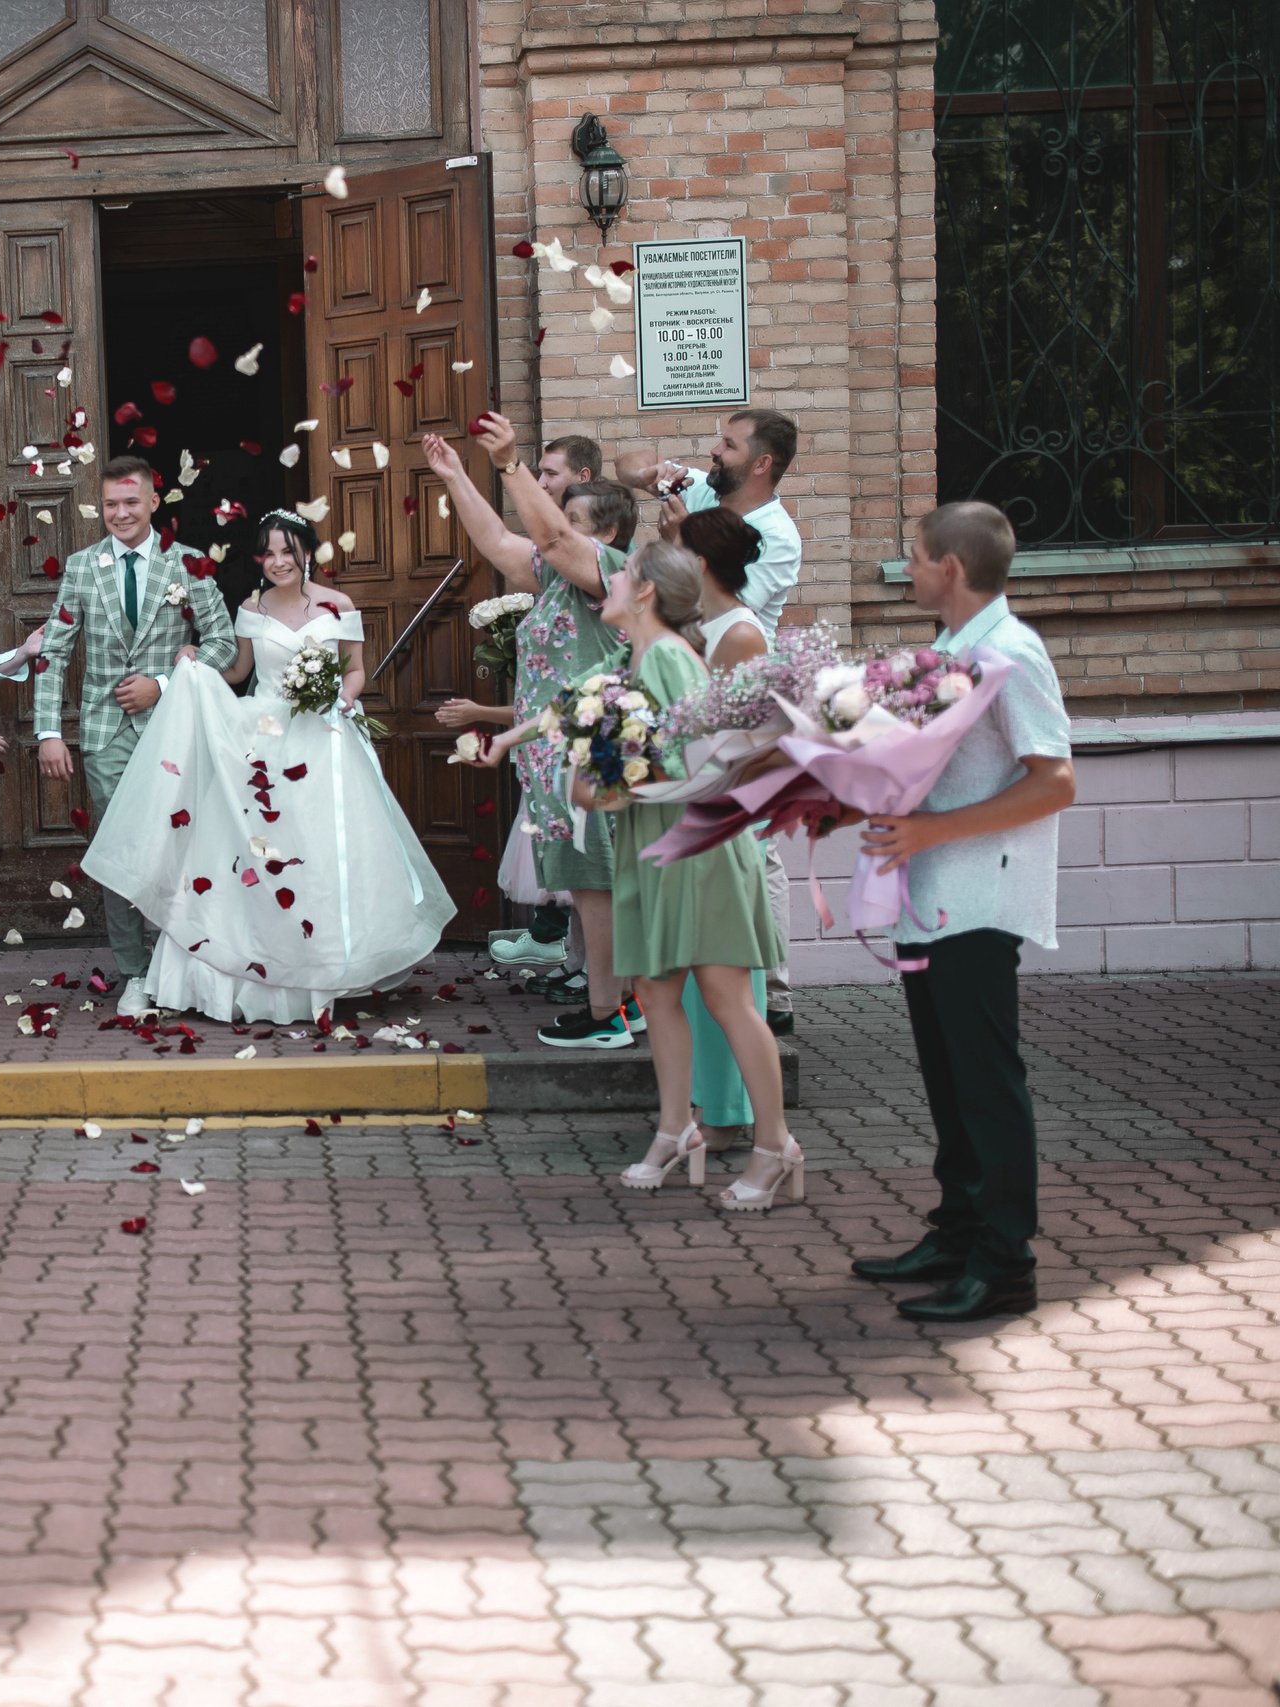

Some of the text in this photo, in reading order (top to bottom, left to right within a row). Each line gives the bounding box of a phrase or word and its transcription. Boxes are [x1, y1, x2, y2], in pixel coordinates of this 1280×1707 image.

[643, 249, 737, 264] УВАЖАЕМЫЕ ПОСЕТИТЕЛИ!
[665, 308, 717, 317] РЕЖИМ РАБОТЫ:
[686, 317, 734, 326] ВОСКРЕСЕНЬЕ
[657, 329, 685, 343] 10.00
[695, 326, 723, 340] 19.00
[663, 351, 688, 362] 13.00
[697, 350, 723, 360] 14.00
[665, 364, 700, 372] ВЫХОДНОЙ
[662, 382, 705, 390] САНИТАРНЫЙ
[647, 390, 684, 398] ПОСЛЕДНЯЯ
[714, 387, 740, 395] МЕСЯЦА
